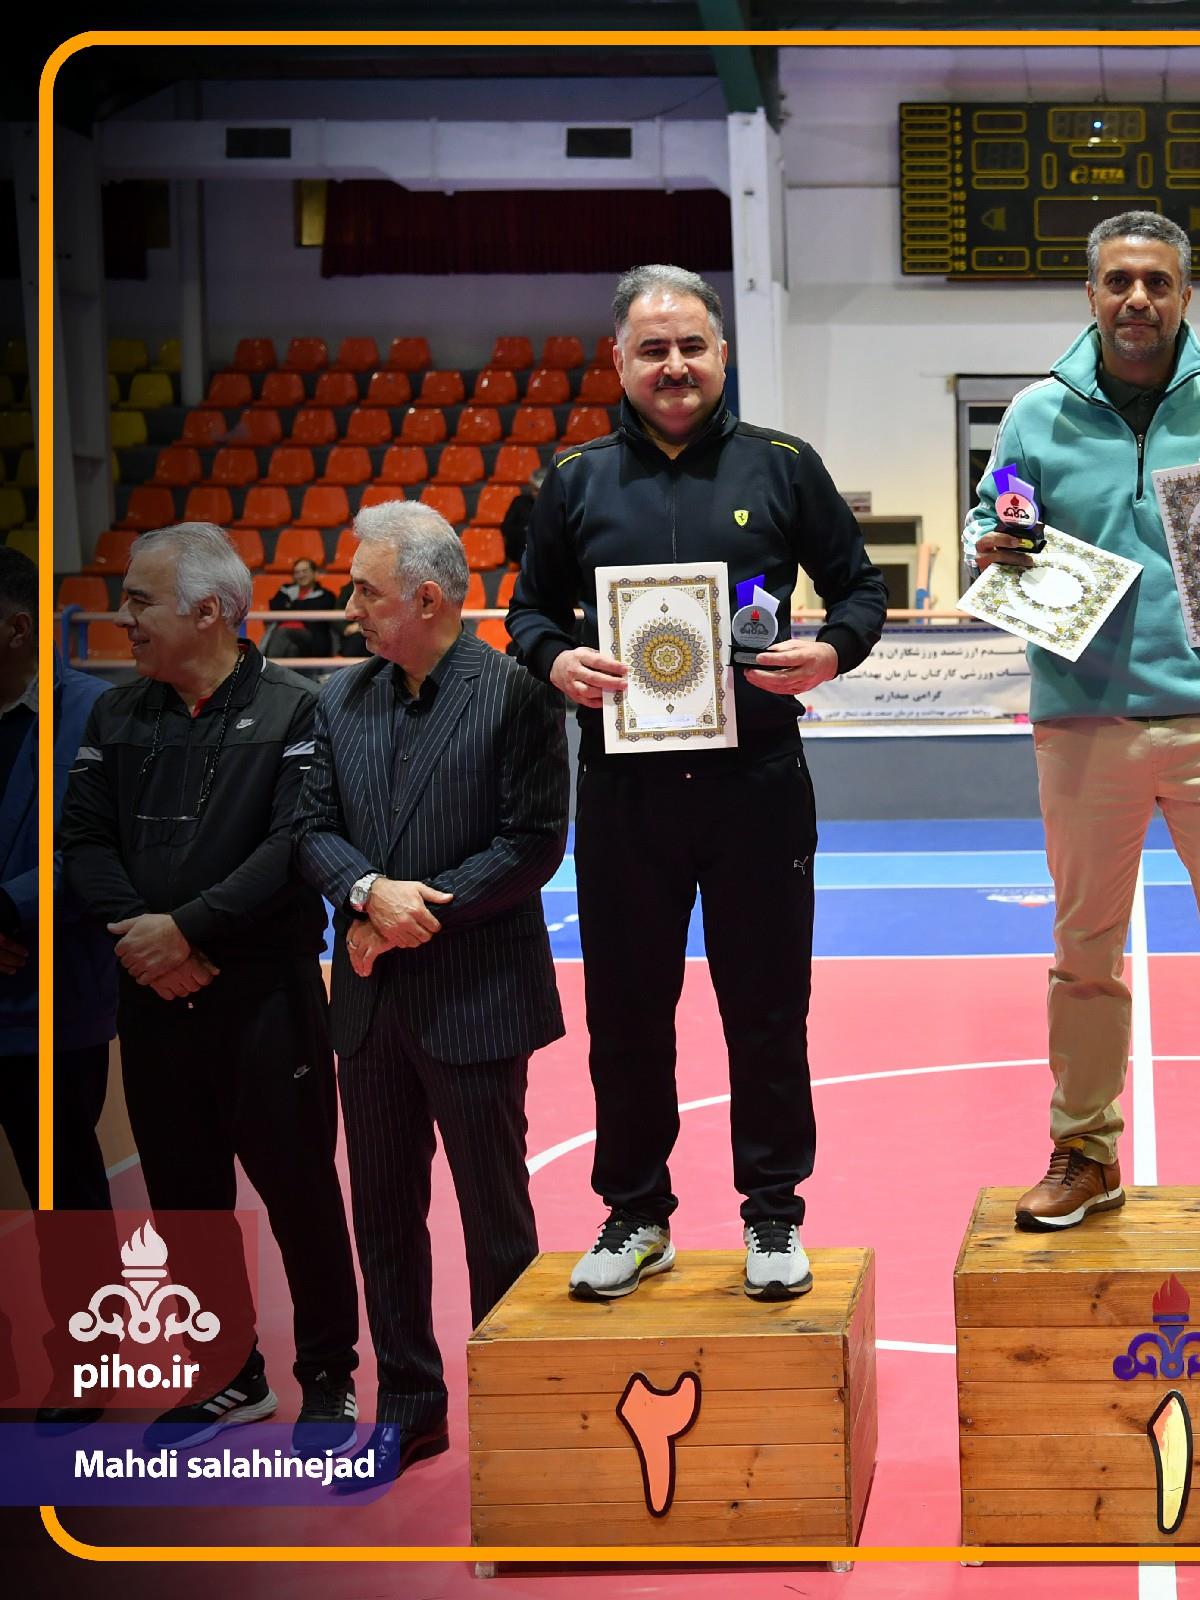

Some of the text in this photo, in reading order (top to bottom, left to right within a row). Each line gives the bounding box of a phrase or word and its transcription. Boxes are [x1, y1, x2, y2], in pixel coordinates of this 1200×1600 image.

[1090, 167, 1125, 180] TETA
[886, 647, 938, 660] ورزشکاران
[846, 670, 882, 679] بهداشت
[885, 669, 917, 681] سازمان
[960, 667, 994, 680] ورزشی
[913, 690, 942, 702] گرامی
